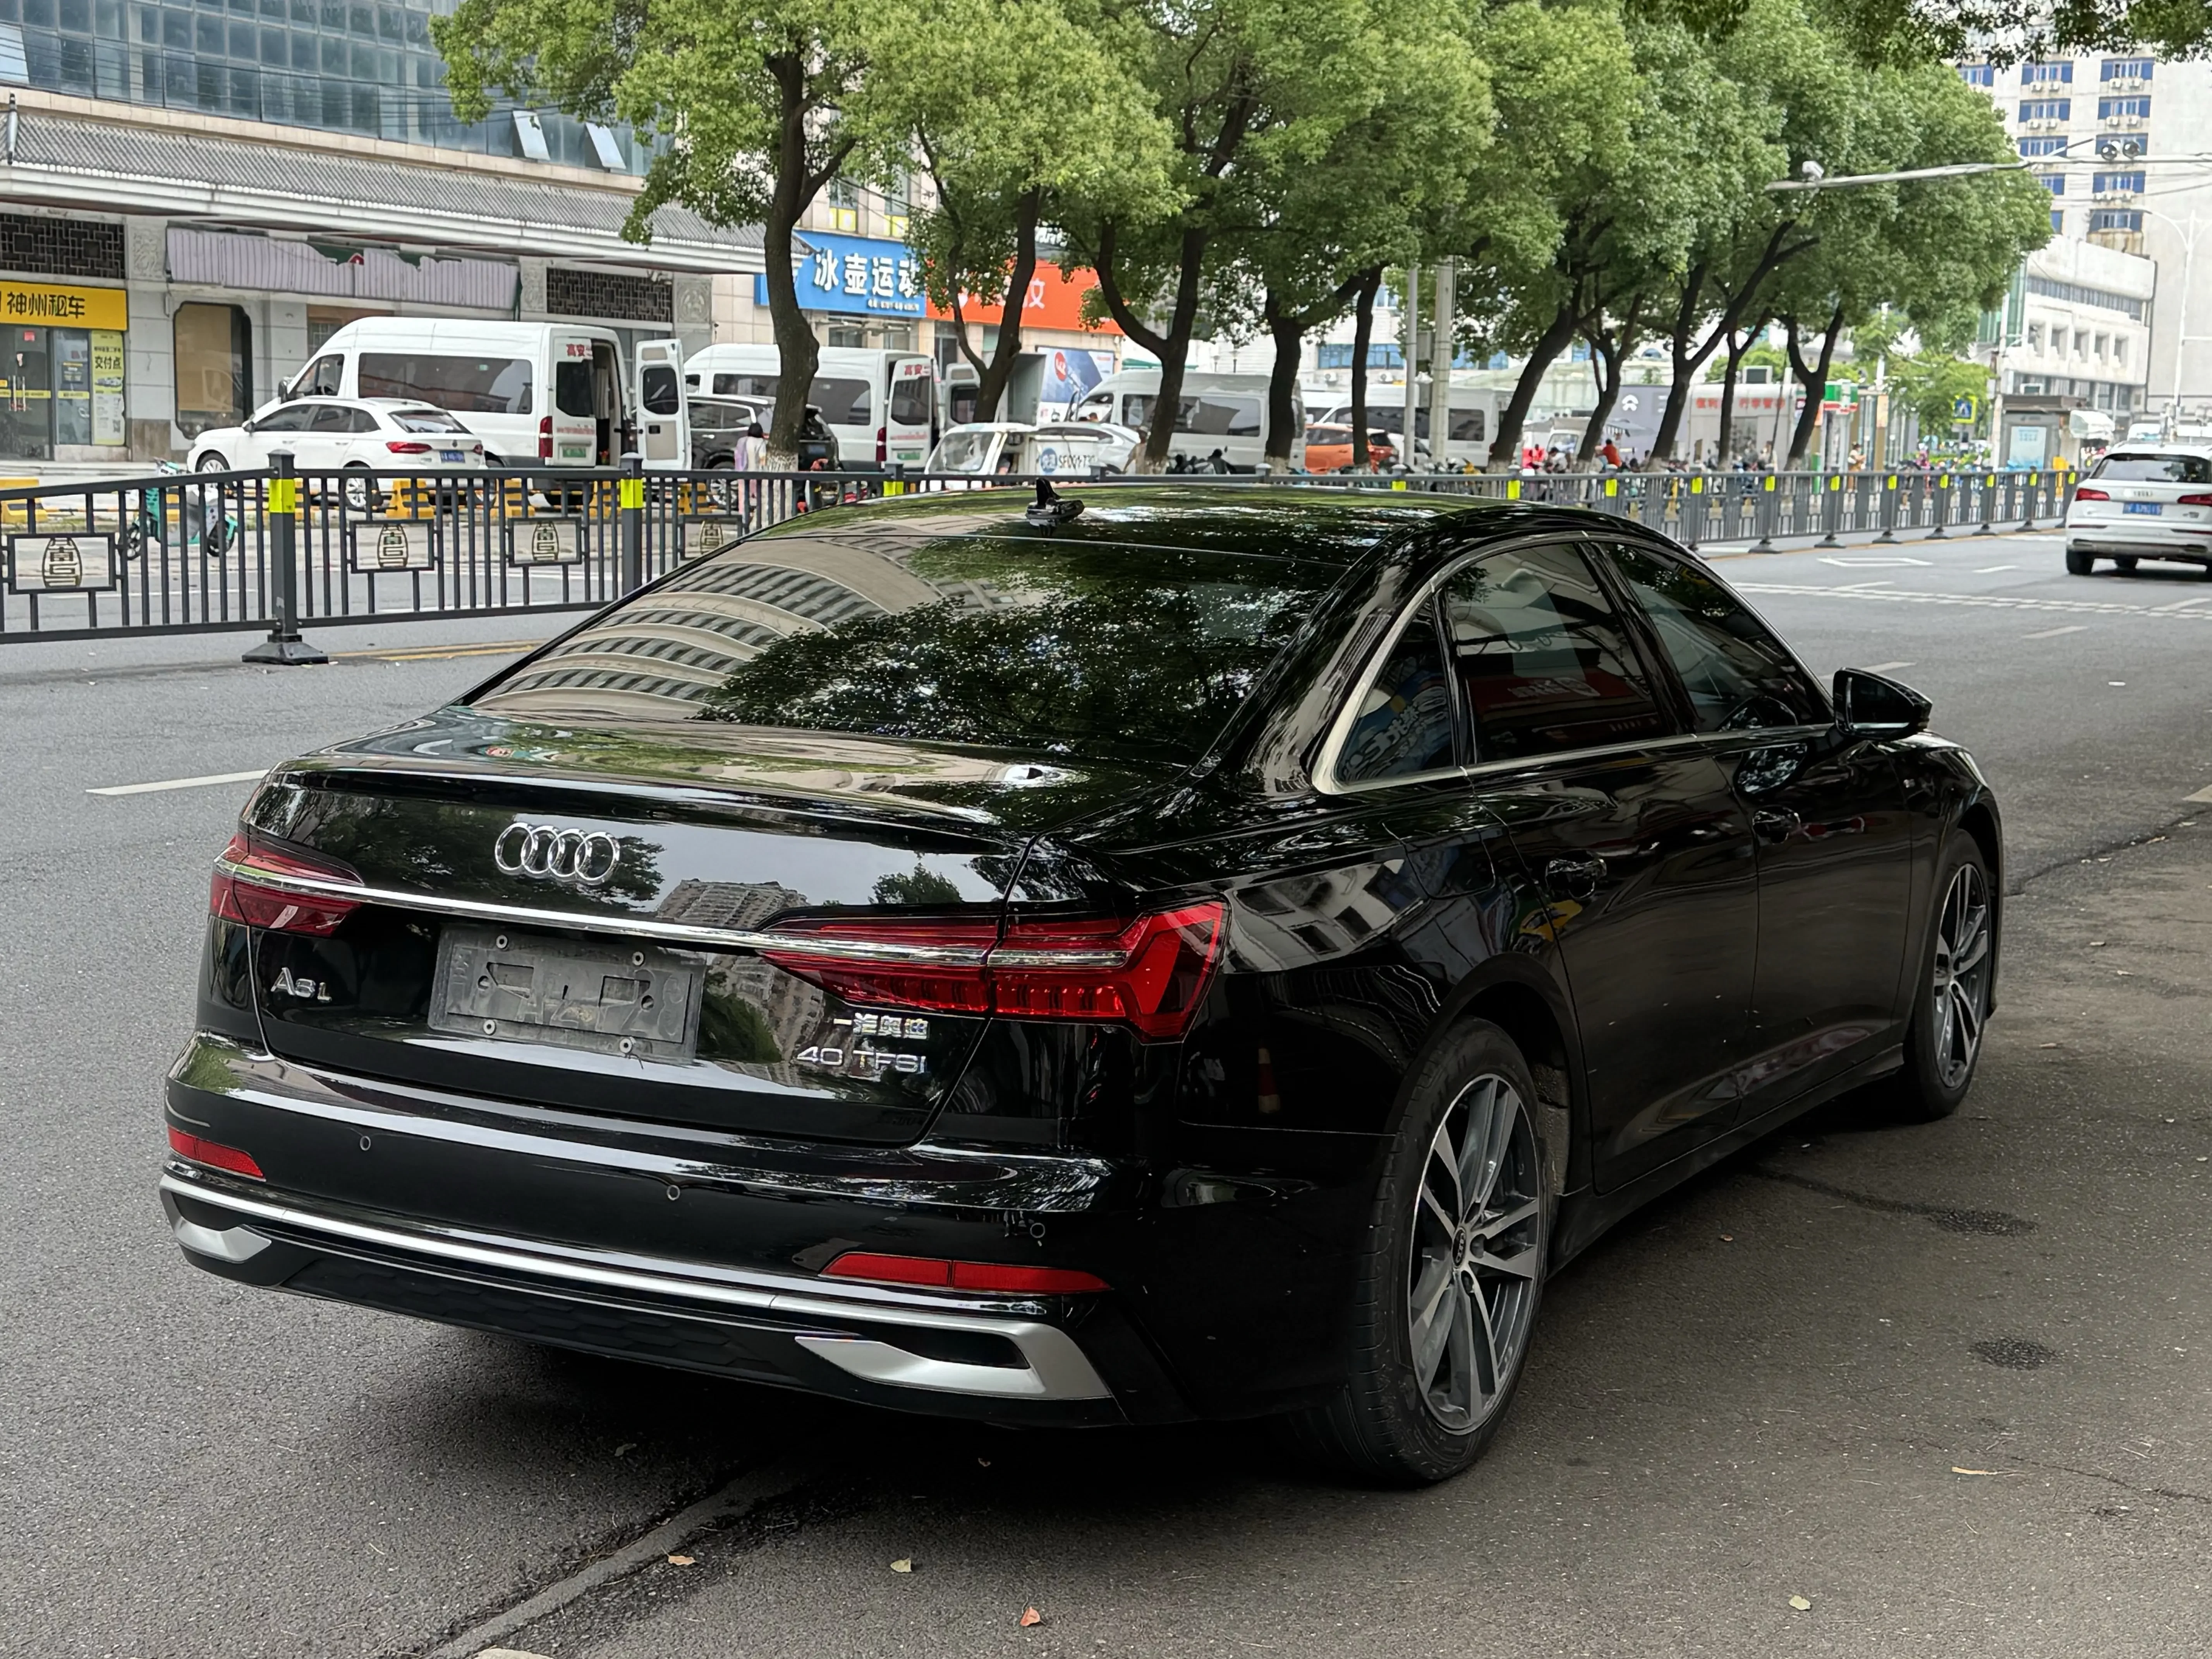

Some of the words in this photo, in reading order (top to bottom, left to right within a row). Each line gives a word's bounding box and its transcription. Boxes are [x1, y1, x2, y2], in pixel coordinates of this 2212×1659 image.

[7, 291, 86, 319] 神州租车
[95, 356, 122, 369] 交付点
[271, 967, 332, 1002] A6L
[797, 1046, 843, 1065] 40
[853, 1049, 926, 1073] TFSI
